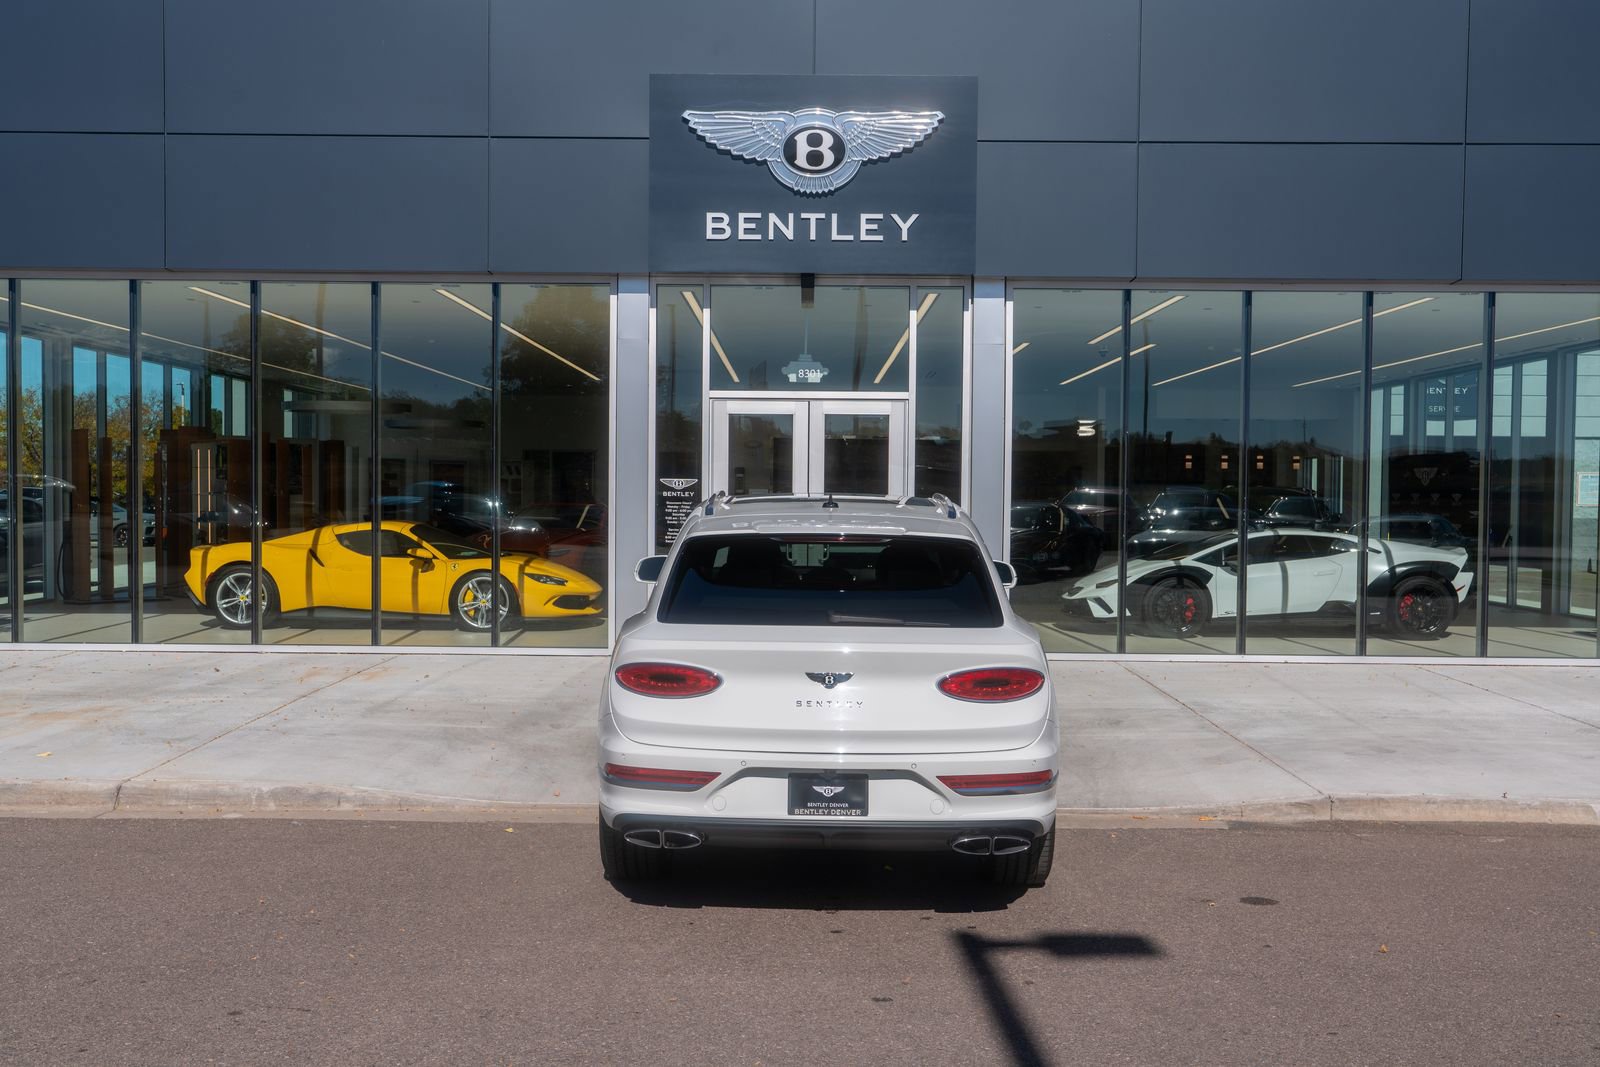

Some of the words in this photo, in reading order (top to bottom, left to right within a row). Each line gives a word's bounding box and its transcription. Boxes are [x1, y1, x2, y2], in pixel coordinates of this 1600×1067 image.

[794, 129, 834, 171] B
[706, 212, 919, 241] BENTLEY
[798, 369, 820, 378] 8301
[1426, 387, 1468, 395] ENEY
[796, 700, 863, 708] BENTEY
